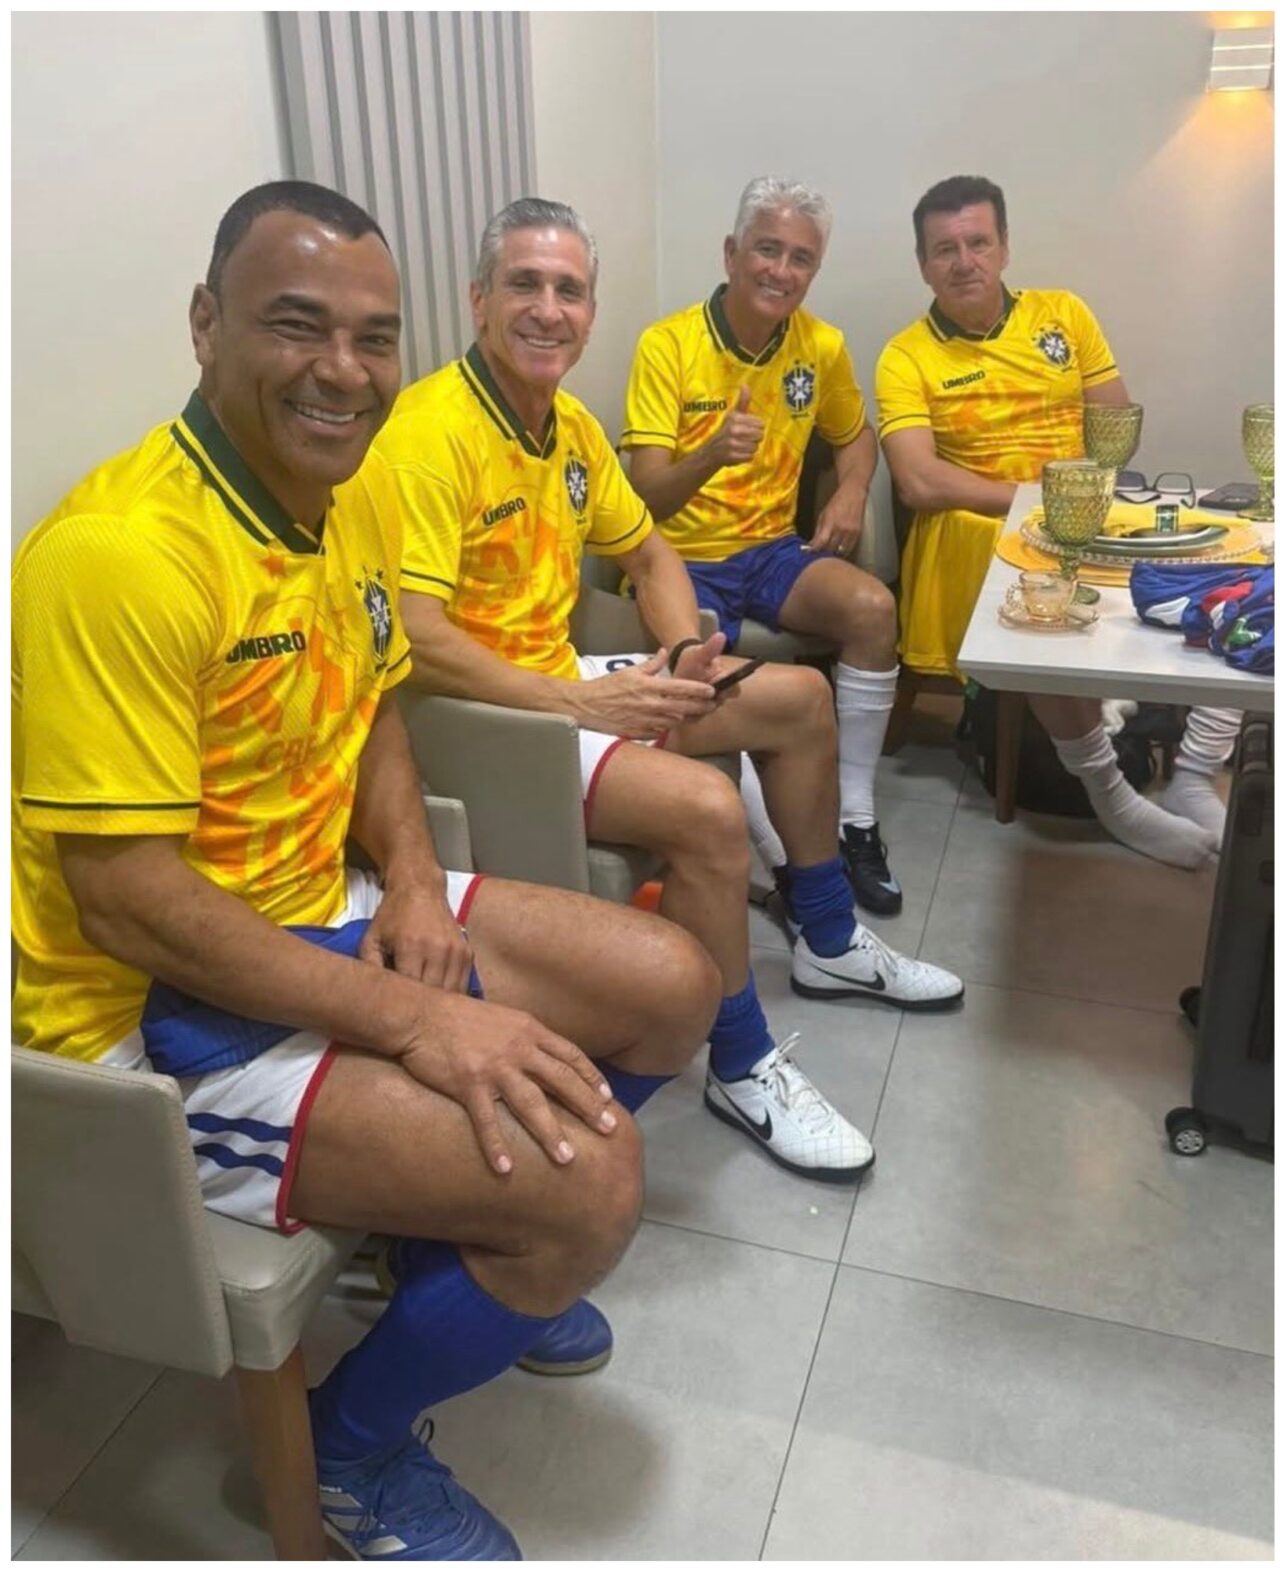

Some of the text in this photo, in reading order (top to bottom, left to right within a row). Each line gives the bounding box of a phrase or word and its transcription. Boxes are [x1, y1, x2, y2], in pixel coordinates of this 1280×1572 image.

[942, 369, 985, 390] UMBRO
[683, 400, 727, 412] UMBRO
[482, 496, 526, 526] UMBRO
[225, 630, 306, 663] UMBRO
